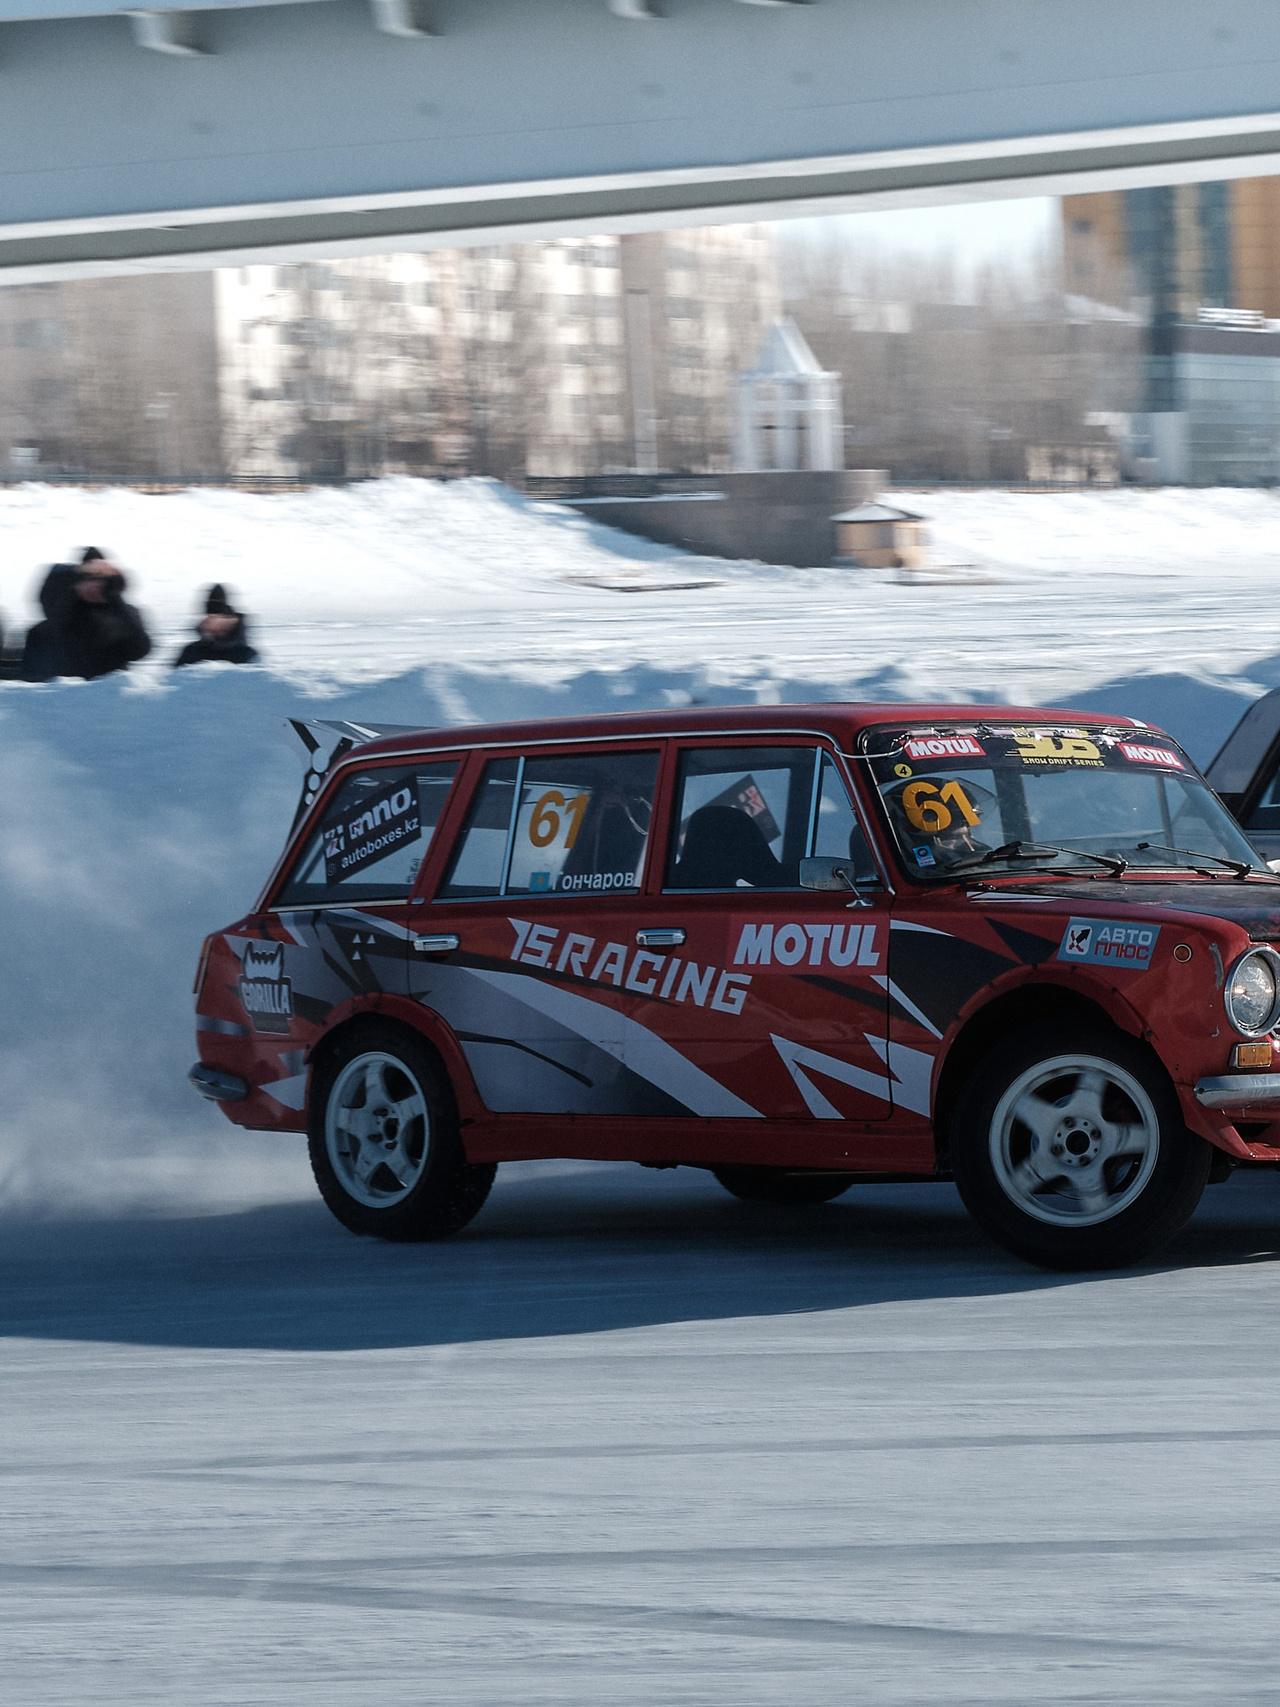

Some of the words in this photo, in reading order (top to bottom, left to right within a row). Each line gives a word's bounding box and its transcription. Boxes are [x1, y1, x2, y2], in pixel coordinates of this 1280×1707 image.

[909, 738, 980, 757] MOTUL
[1123, 745, 1182, 767] MOTUL
[899, 766, 908, 776] 4
[1048, 758, 1073, 766] DRIFT
[1074, 759, 1106, 767] SERIES
[902, 781, 981, 833] 61
[529, 790, 591, 849] 61
[341, 818, 420, 869] autoboxes.kz
[552, 871, 634, 891] Гончаров
[733, 923, 880, 967] MOTUL
[1097, 927, 1153, 946] АВТО
[1094, 941, 1150, 961] ПЛЮС
[241, 982, 291, 1014] GORILLA
